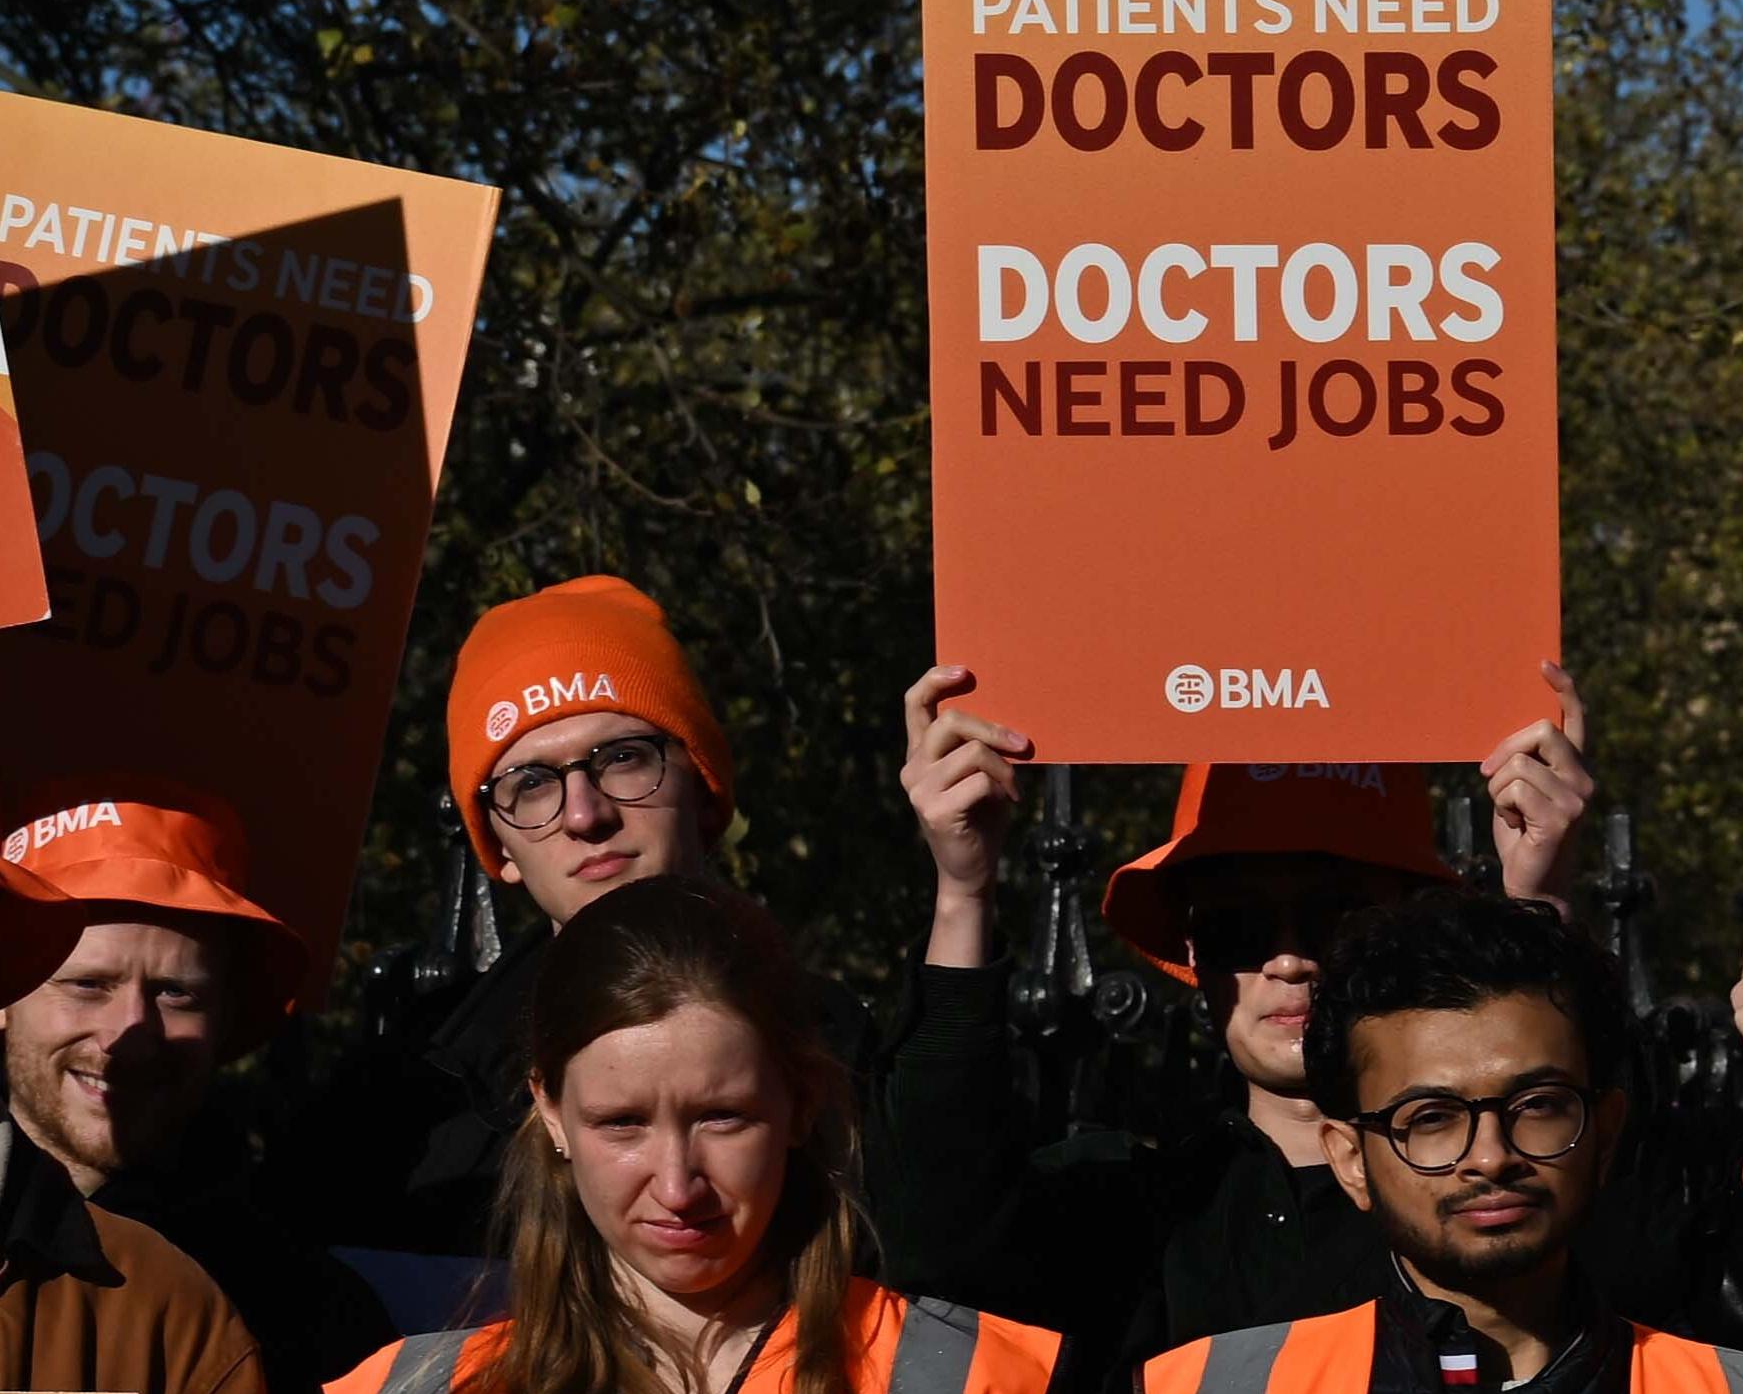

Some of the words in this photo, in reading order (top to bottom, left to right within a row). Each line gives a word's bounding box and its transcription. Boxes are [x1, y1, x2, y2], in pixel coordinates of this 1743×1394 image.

[973, 50, 1503, 152] DOCTORS
[0, 193, 264, 292] PATIENTS
[274, 248, 433, 323] NEED
[978, 242, 1504, 343] DOCTORS
[980, 360, 1245, 437] NEED
[1268, 359, 1506, 451] JOBS
[26, 450, 380, 610] OCTORS
[146, 591, 357, 700] JOBS
[522, 672, 618, 716] BMA
[1220, 668, 1330, 709] BMA
[34, 802, 122, 849] BMA
